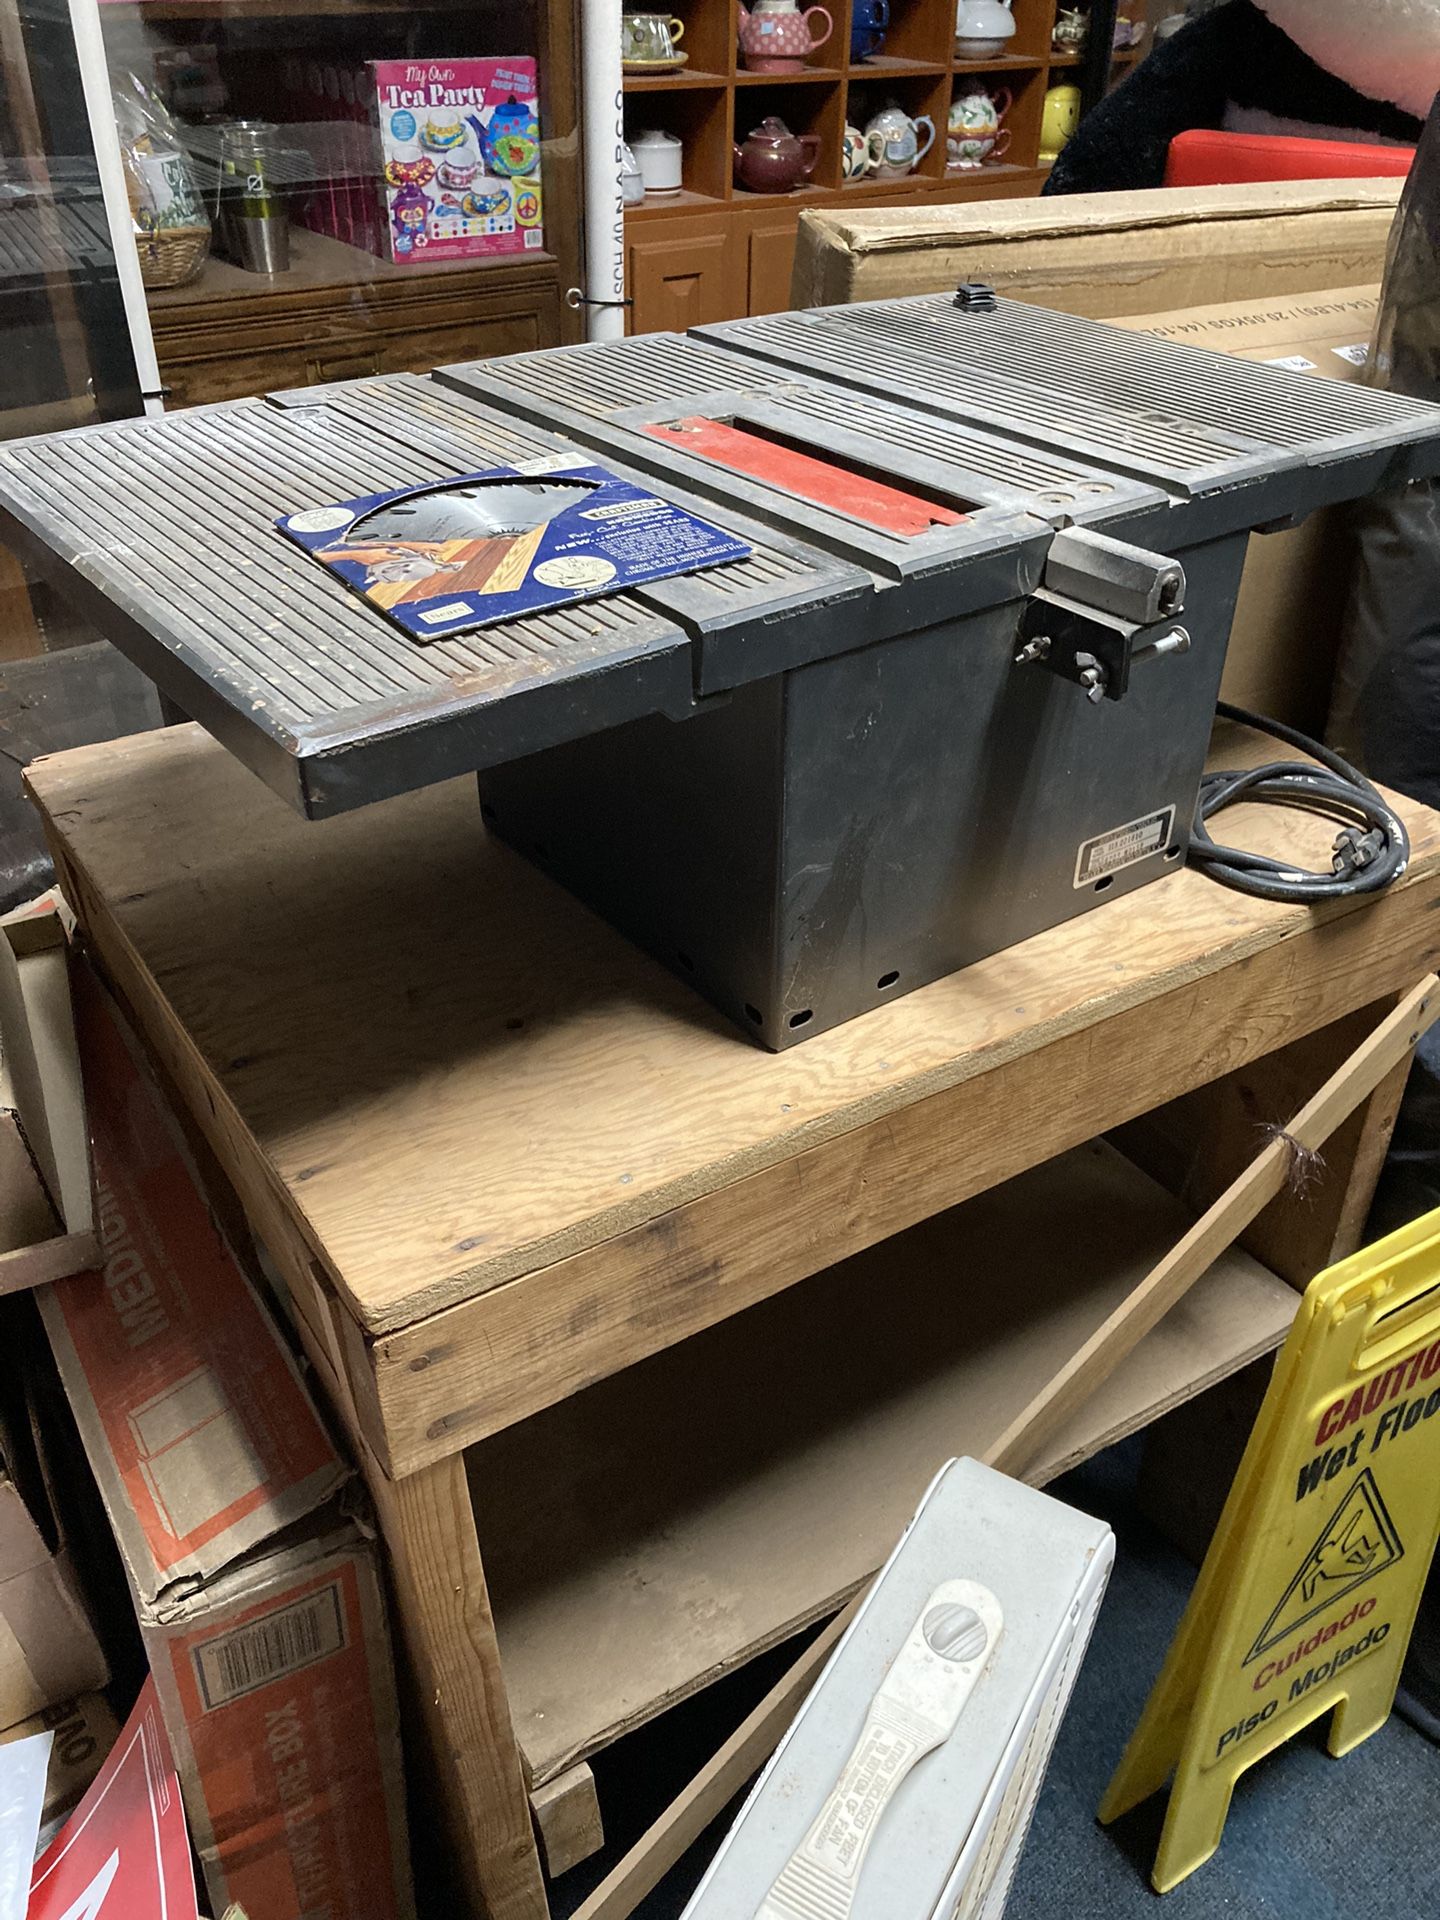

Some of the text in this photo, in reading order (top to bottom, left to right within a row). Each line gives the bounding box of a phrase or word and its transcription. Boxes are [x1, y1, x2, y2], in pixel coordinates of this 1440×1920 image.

[386, 84, 487, 111] Tea Party
[405, 65, 456, 87] My Own
[1296, 1429, 1367, 1503] Wet
[1252, 1598, 1378, 1691] Cuidado
[1216, 1623, 1391, 1758] Piso Mojado
[828, 1817, 850, 1847] FAN
